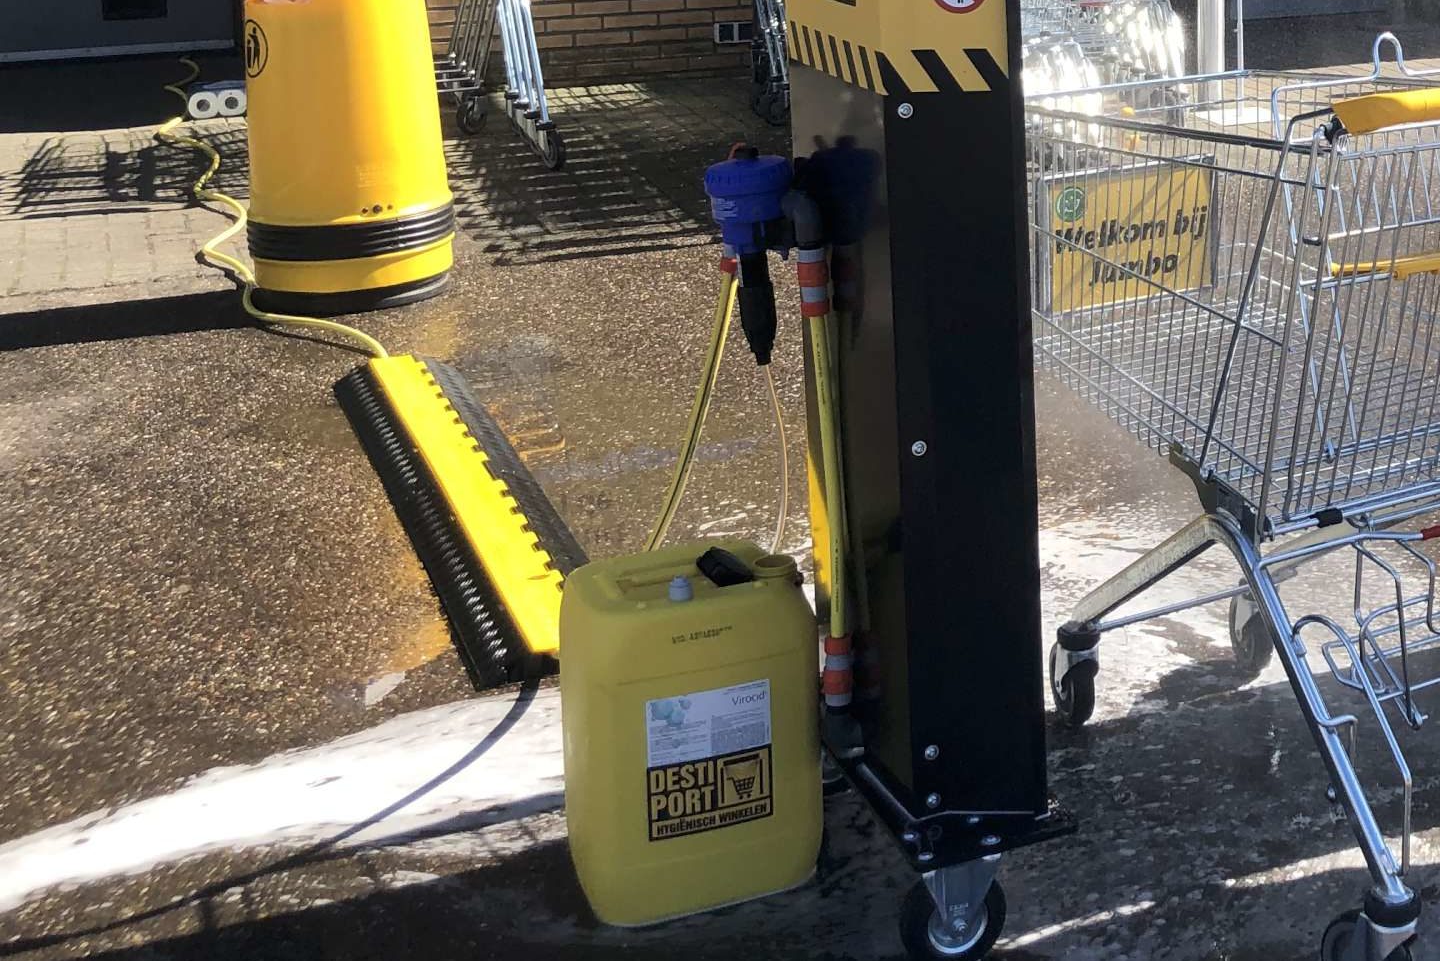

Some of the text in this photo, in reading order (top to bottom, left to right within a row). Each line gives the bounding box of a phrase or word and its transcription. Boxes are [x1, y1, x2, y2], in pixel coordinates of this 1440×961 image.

[1055, 205, 1208, 254] Welkom bij
[1088, 250, 1179, 287] Jumbo
[650, 760, 715, 794] DESTI
[651, 786, 715, 820] PORT
[719, 802, 768, 823] WINKELEN
